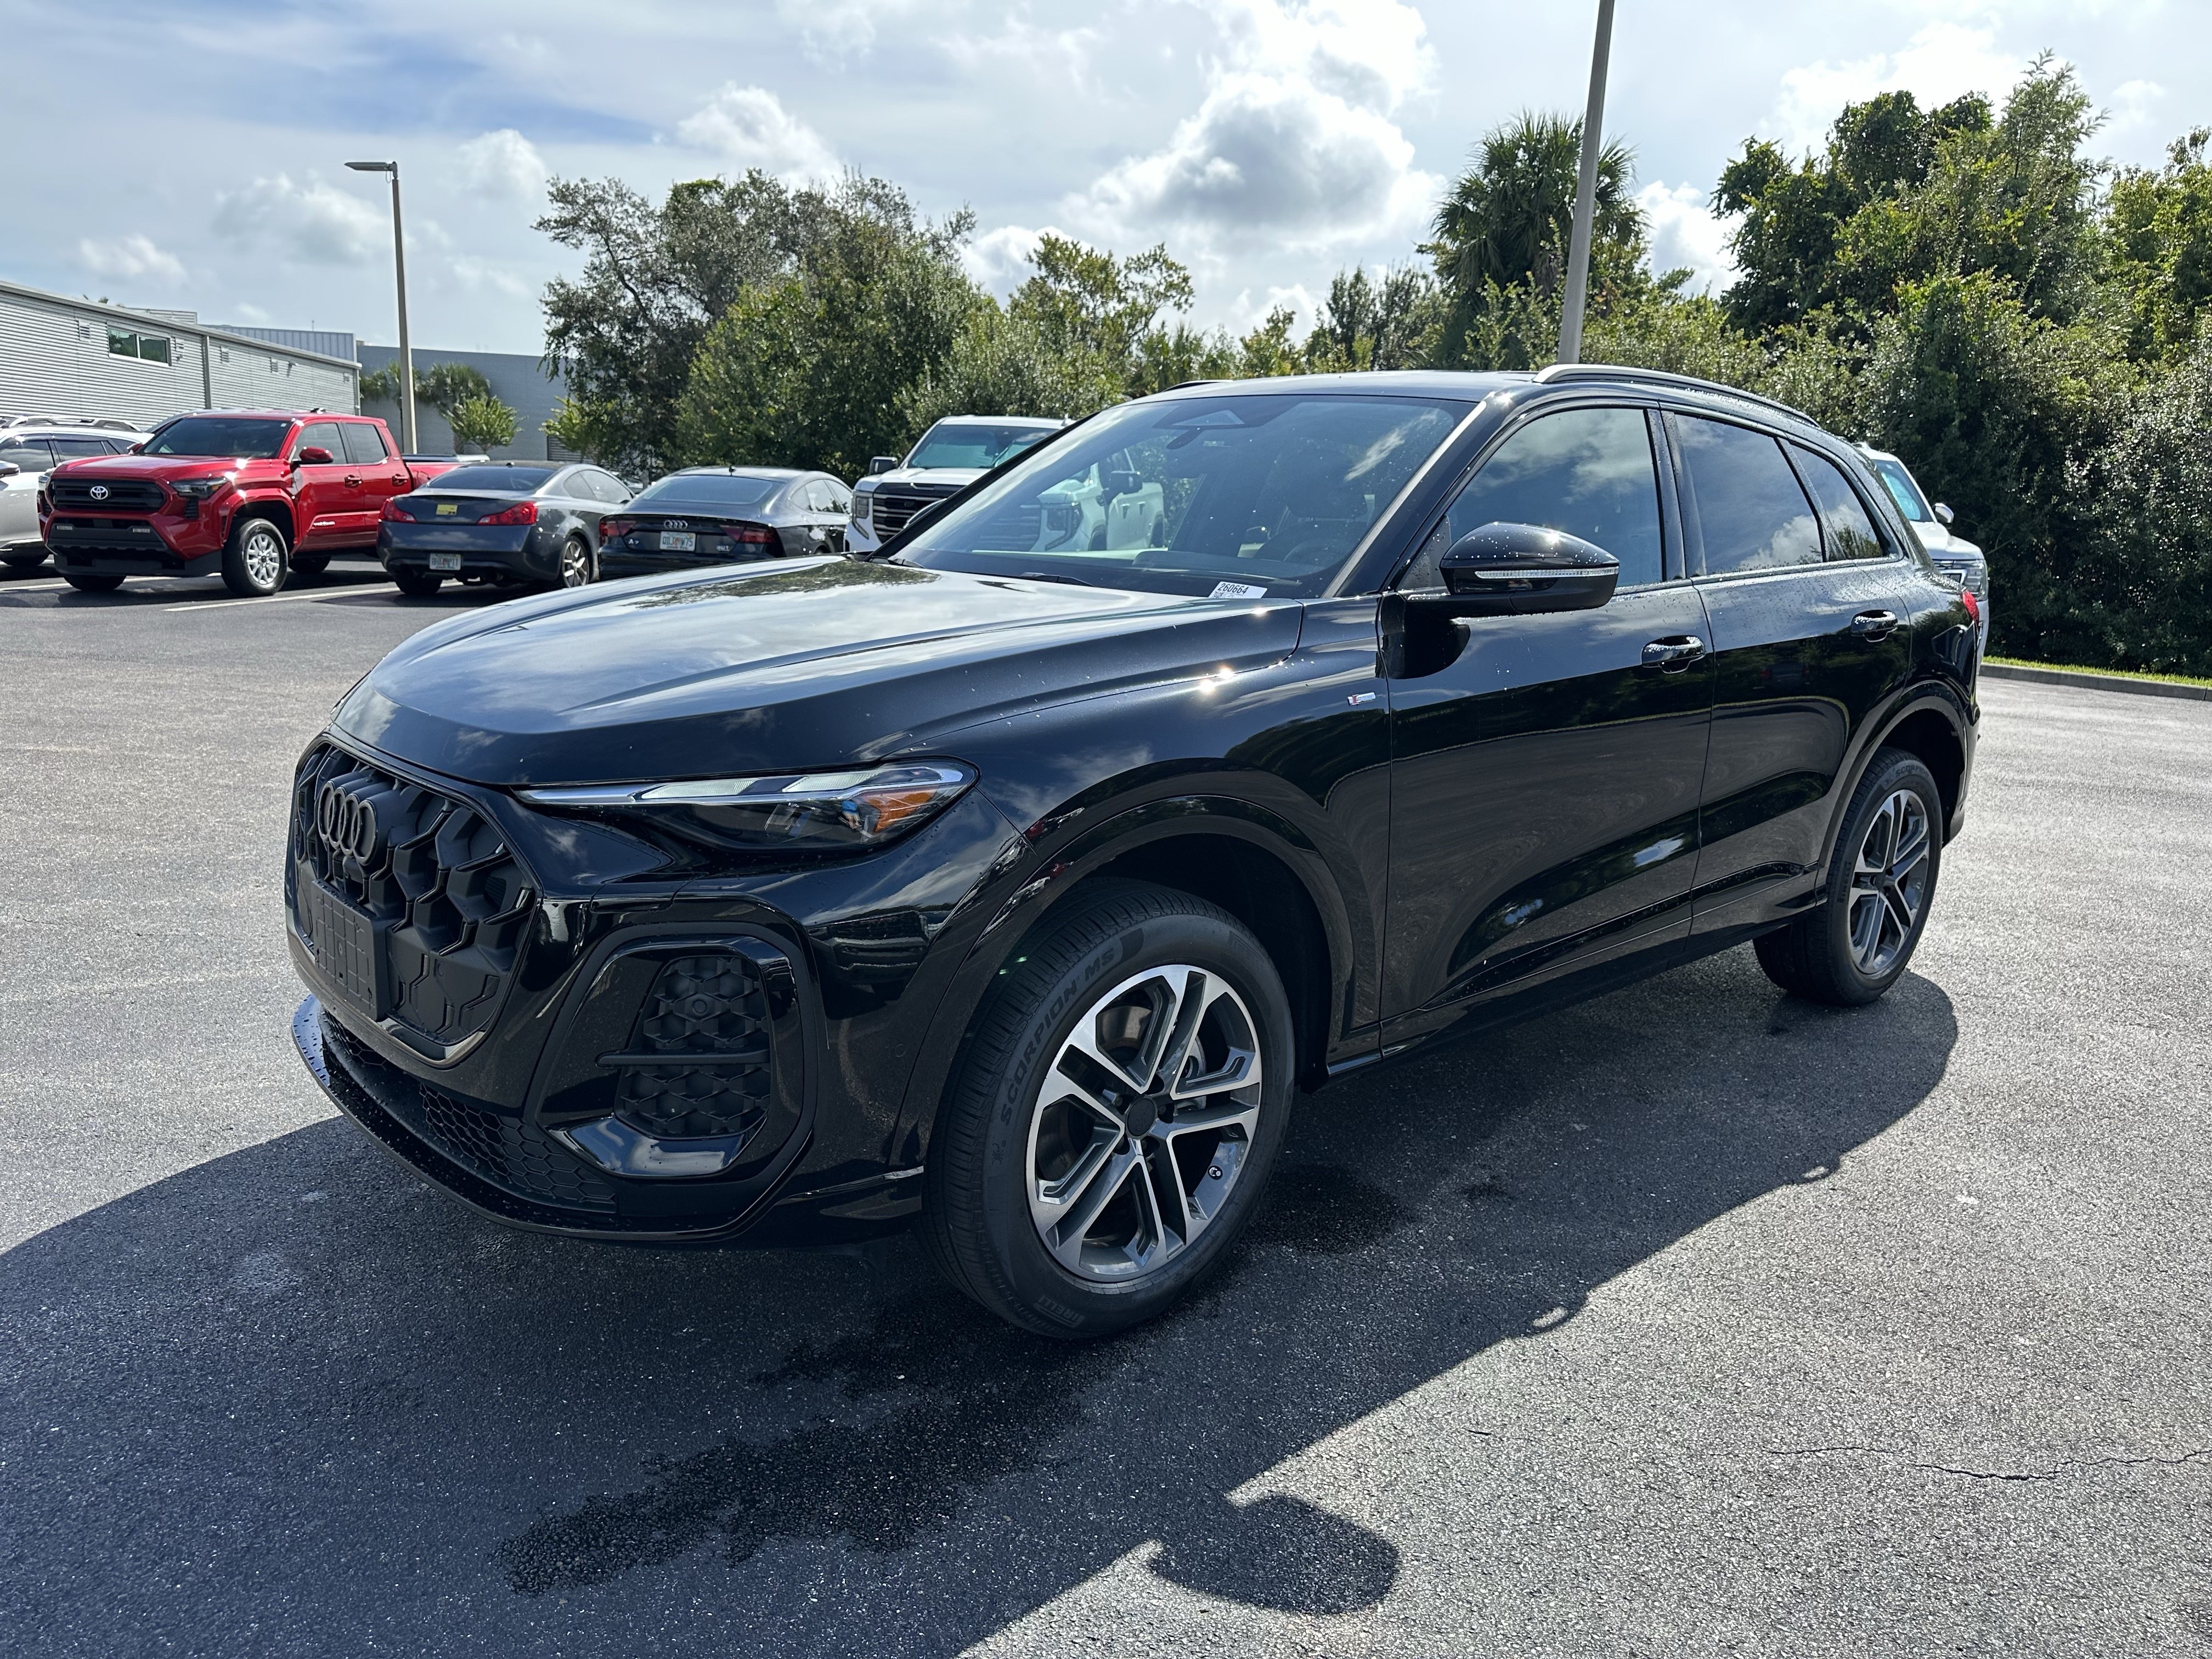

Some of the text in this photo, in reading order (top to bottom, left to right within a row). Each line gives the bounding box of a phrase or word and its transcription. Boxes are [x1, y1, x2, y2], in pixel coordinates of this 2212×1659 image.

[1217, 583, 1249, 595] 260664
[1000, 947, 1116, 1126] SCORPION MS
